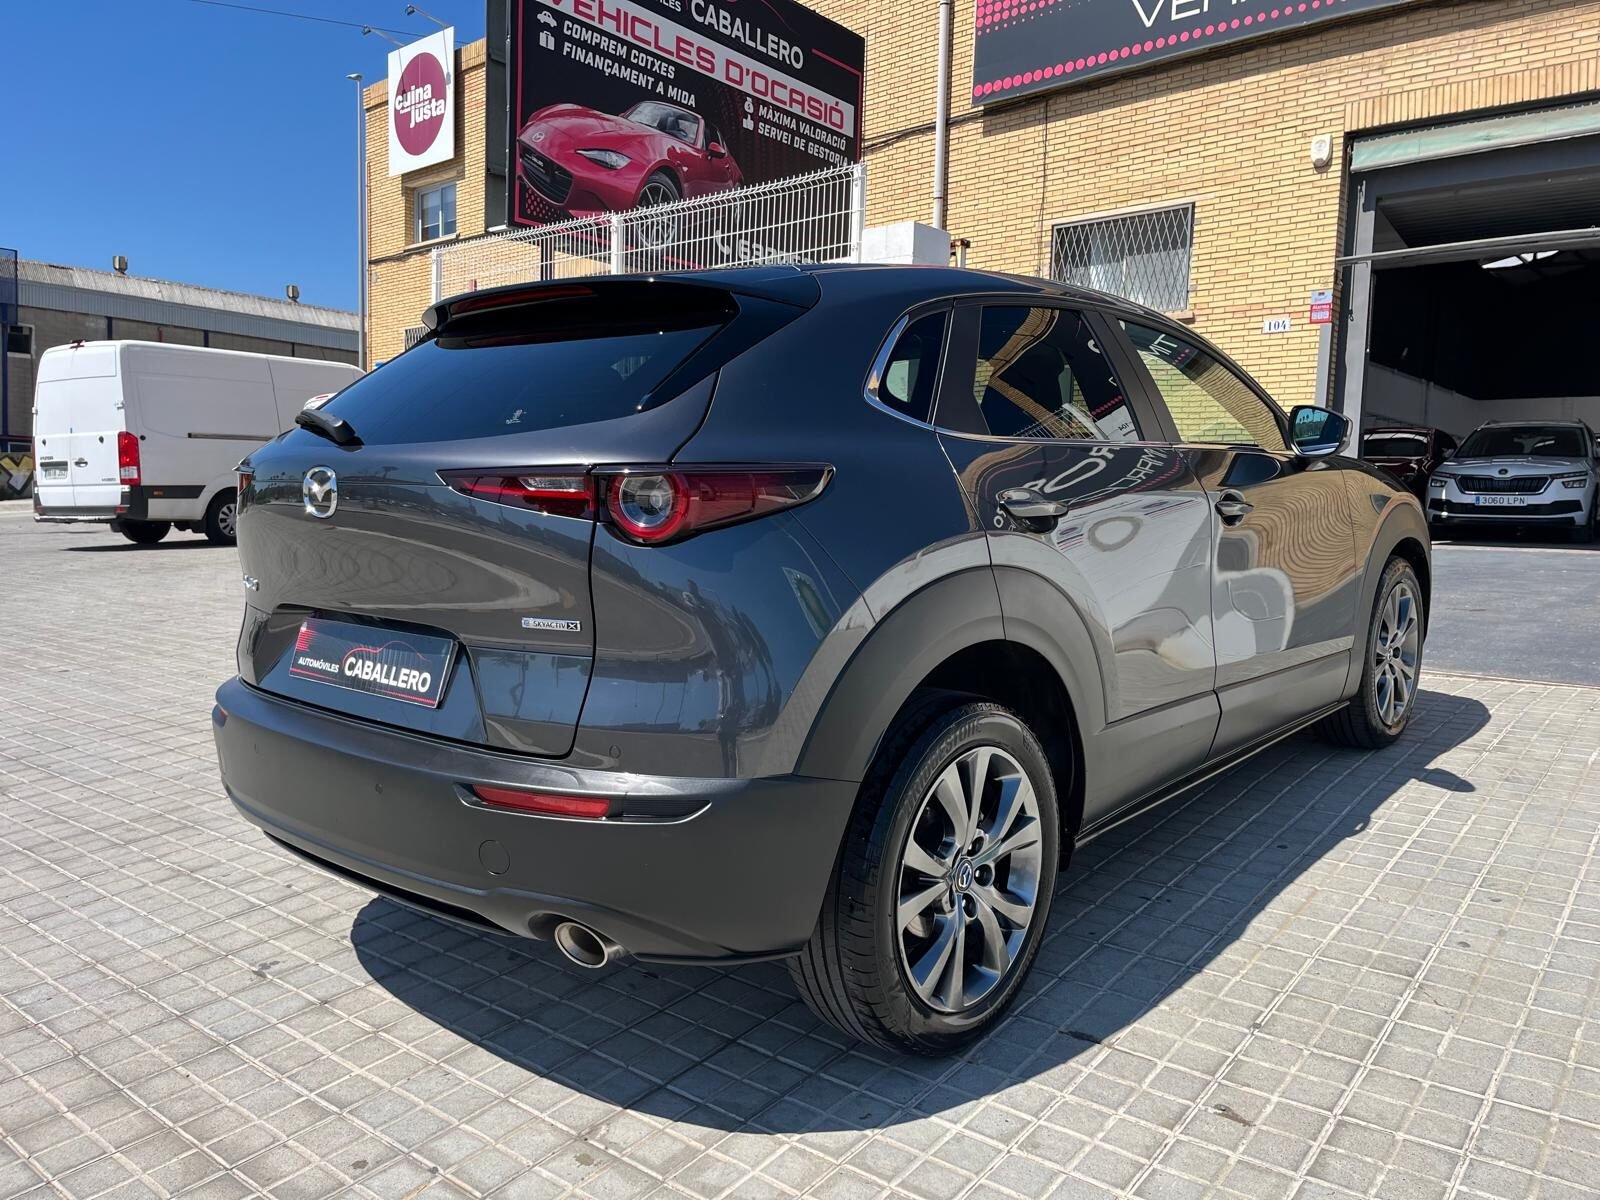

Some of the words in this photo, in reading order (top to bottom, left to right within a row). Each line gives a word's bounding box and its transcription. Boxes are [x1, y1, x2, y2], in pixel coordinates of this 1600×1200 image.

[563, 20, 627, 59] COMPREM
[630, 49, 676, 80] COTXES
[691, 0, 804, 70] CABALLERO
[551, 0, 716, 74] EHICLES
[725, 58, 845, 130] D'OCASIÓ
[562, 41, 655, 90] FINANÇAMENT
[656, 81, 664, 95] A
[667, 85, 696, 108] MIDA
[395, 83, 432, 111] cuina
[409, 98, 445, 129] justa
[758, 104, 797, 131] MÀXIMA
[799, 121, 847, 151] VALORACIÓ
[758, 122, 792, 145] SERVEI
[793, 136, 806, 151] DE
[1268, 319, 1287, 332] 104
[1482, 496, 1505, 505] 3060
[1507, 496, 1525, 505] LPN
[297, 656, 340, 673] AUTOMÓVILES
[344, 656, 431, 693] CABALLERO
